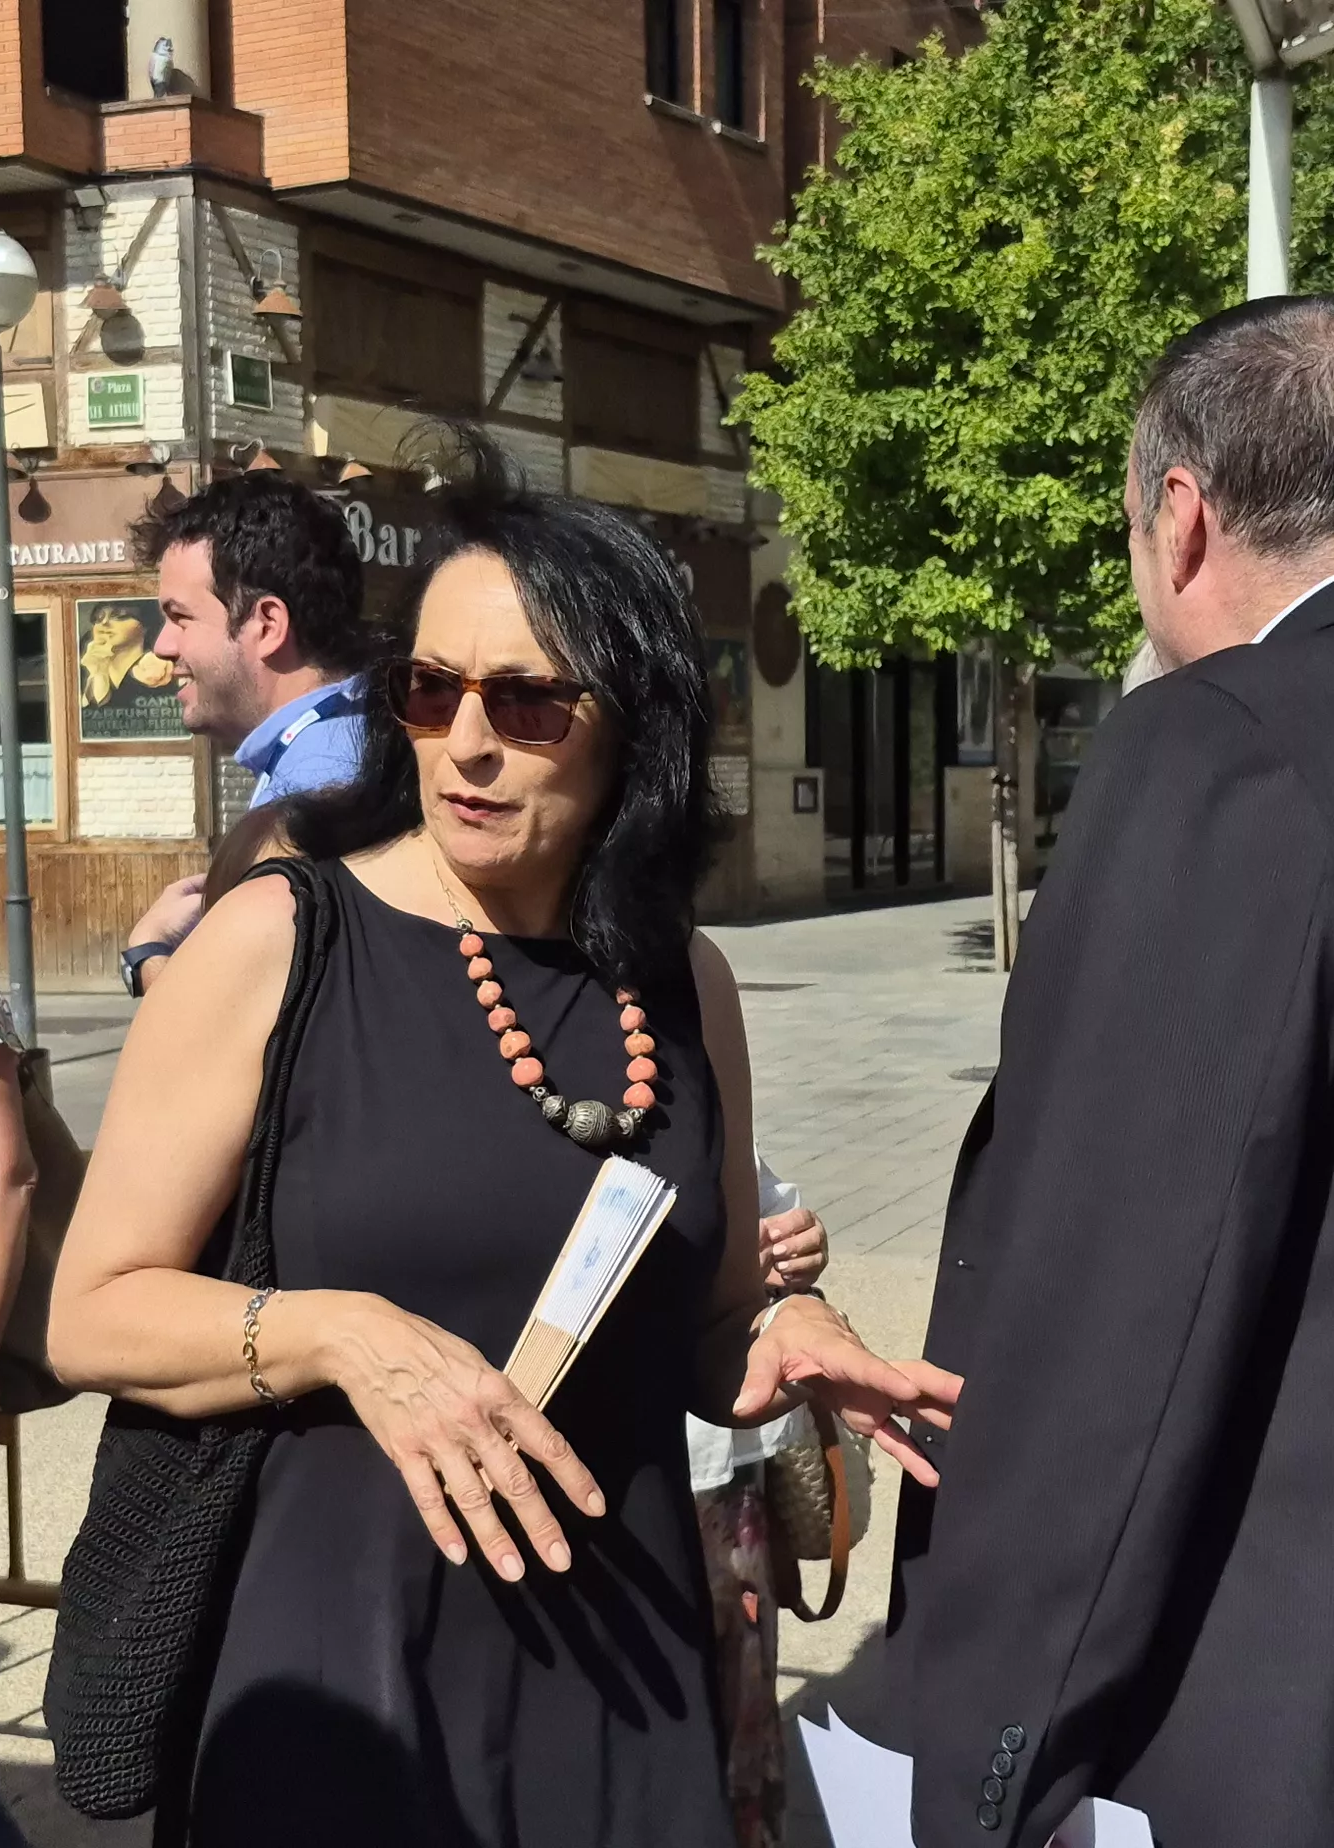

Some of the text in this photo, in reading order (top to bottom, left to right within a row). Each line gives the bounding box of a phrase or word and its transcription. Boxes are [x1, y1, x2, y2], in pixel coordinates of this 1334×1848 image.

[107, 381, 132, 394] Plaza
[344, 500, 422, 567] Bar
[135, 695, 183, 707] GANT
